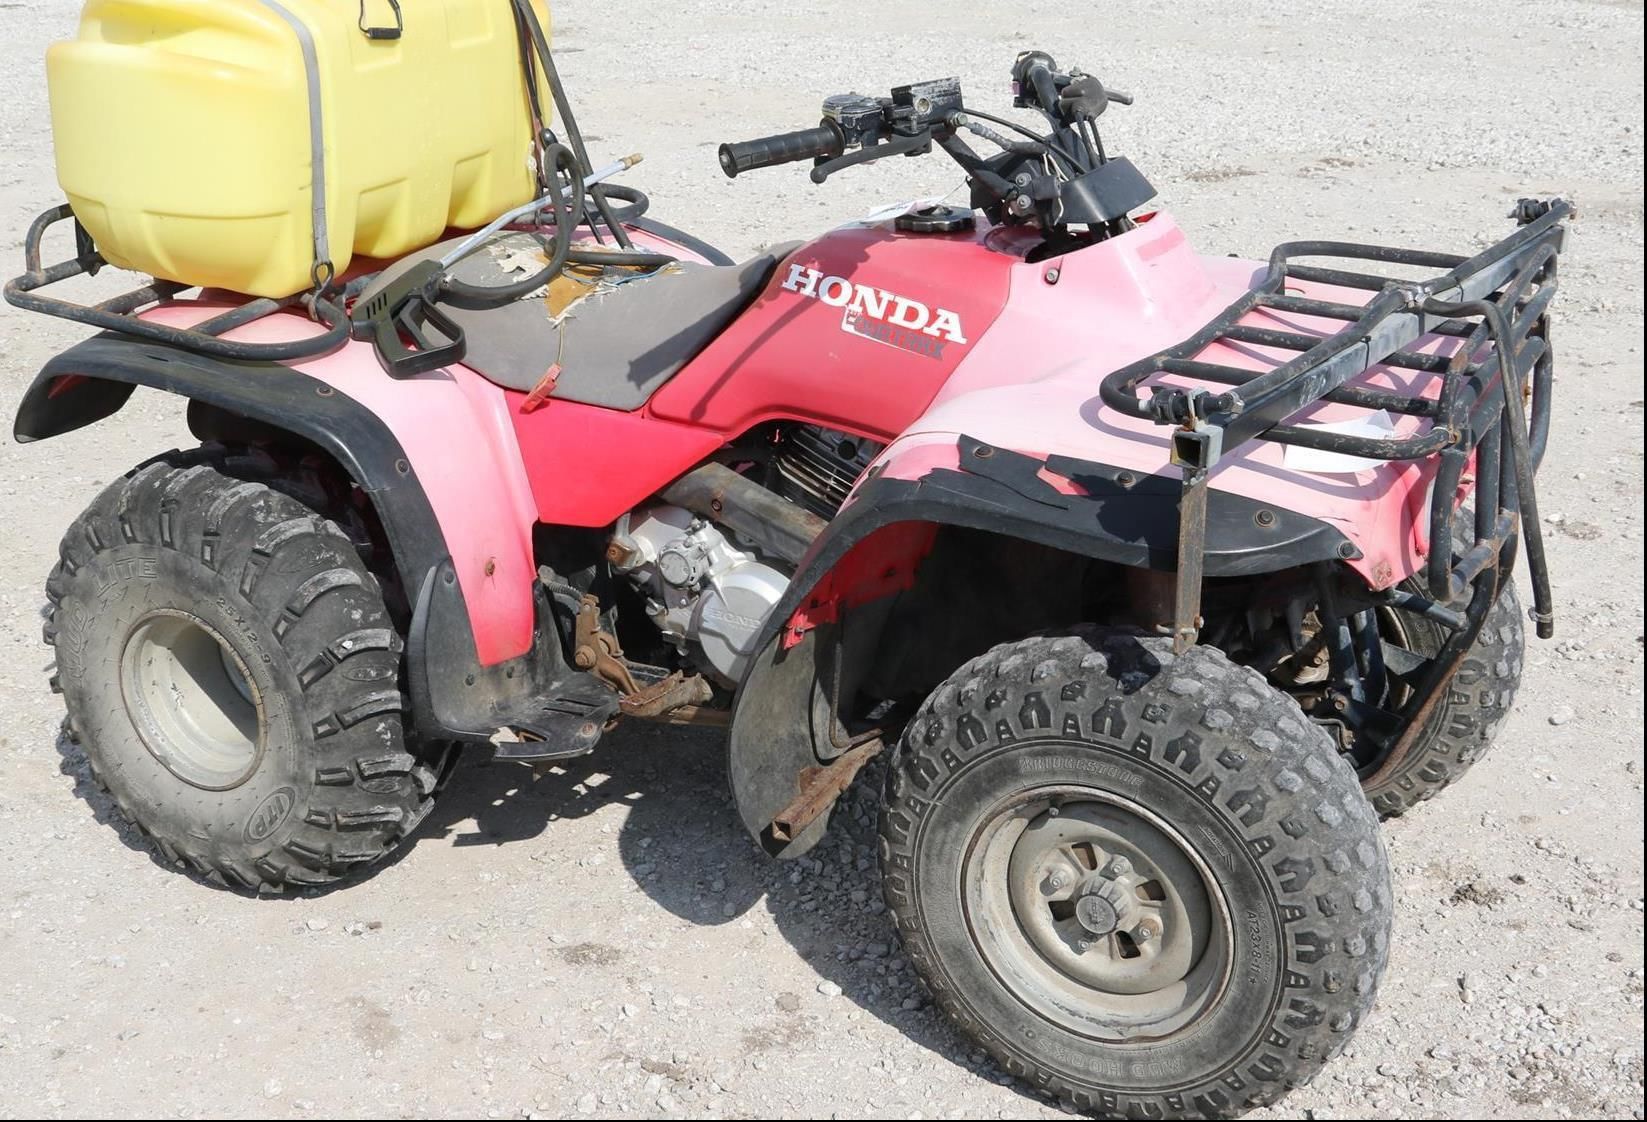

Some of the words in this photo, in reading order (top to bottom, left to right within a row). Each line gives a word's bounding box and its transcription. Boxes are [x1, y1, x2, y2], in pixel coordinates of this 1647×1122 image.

[782, 264, 967, 345] HONDA
[97, 557, 158, 598] LITE
[255, 795, 285, 837] ITP
